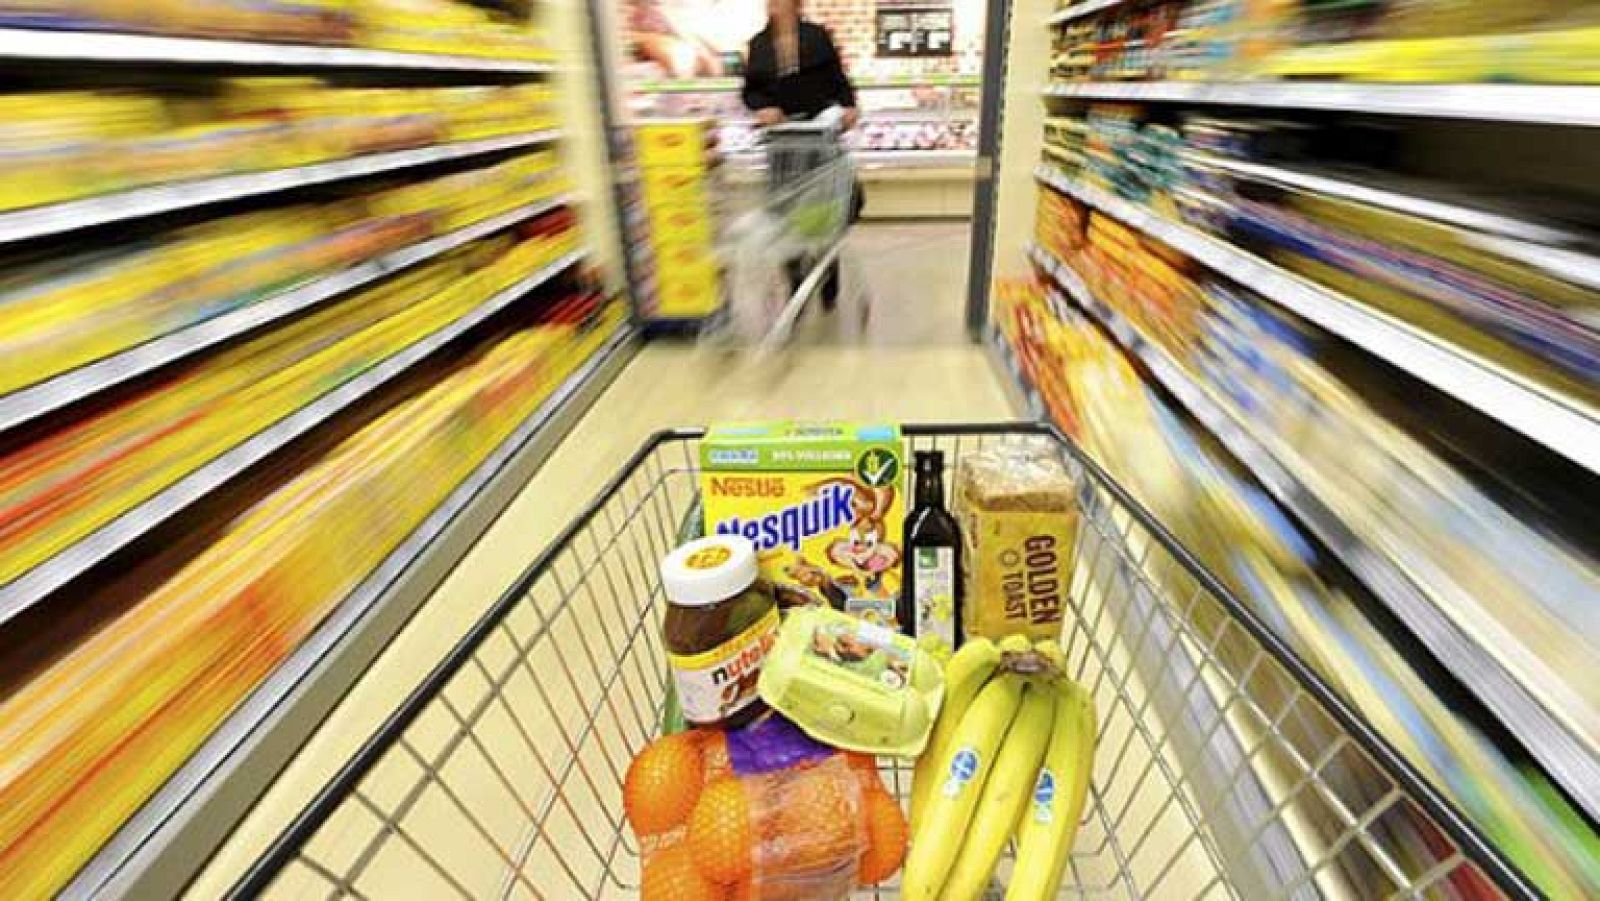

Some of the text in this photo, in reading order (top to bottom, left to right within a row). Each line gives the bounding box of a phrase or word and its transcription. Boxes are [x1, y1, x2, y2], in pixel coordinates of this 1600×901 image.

[1002, 570, 1027, 618] TOAST
[1024, 534, 1061, 624] GOLDEN
[711, 632, 777, 685] nutell
